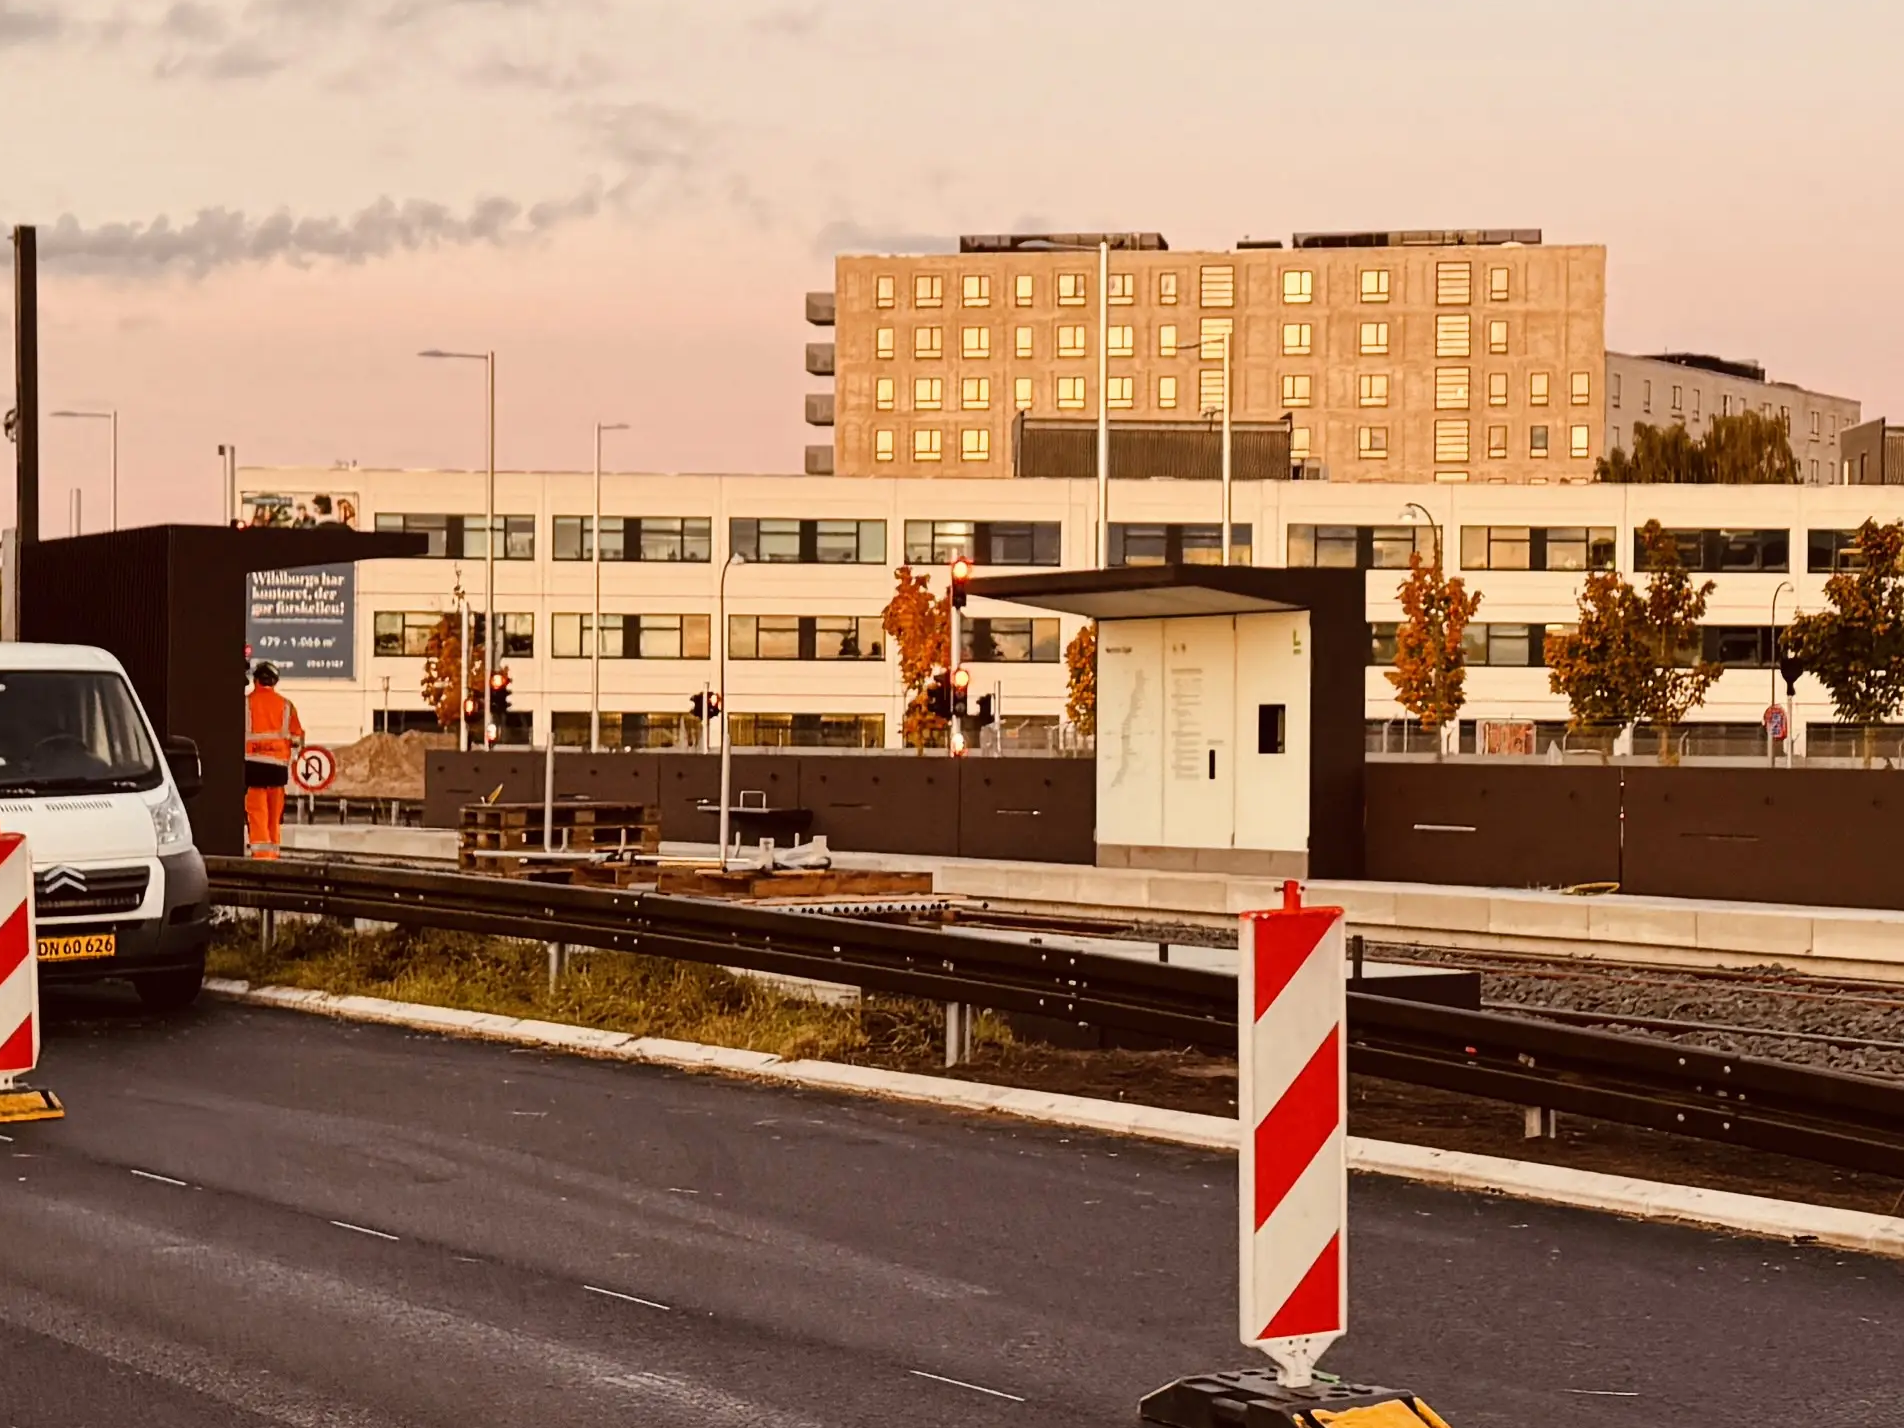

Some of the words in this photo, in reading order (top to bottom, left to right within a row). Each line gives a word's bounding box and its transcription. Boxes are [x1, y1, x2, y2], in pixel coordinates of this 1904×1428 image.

[322, 571, 345, 586] har
[314, 586, 338, 600] der
[276, 601, 345, 616] forskellen!
[38, 941, 60, 956] DN
[63, 939, 82, 954] 60
[85, 937, 113, 953] 626
